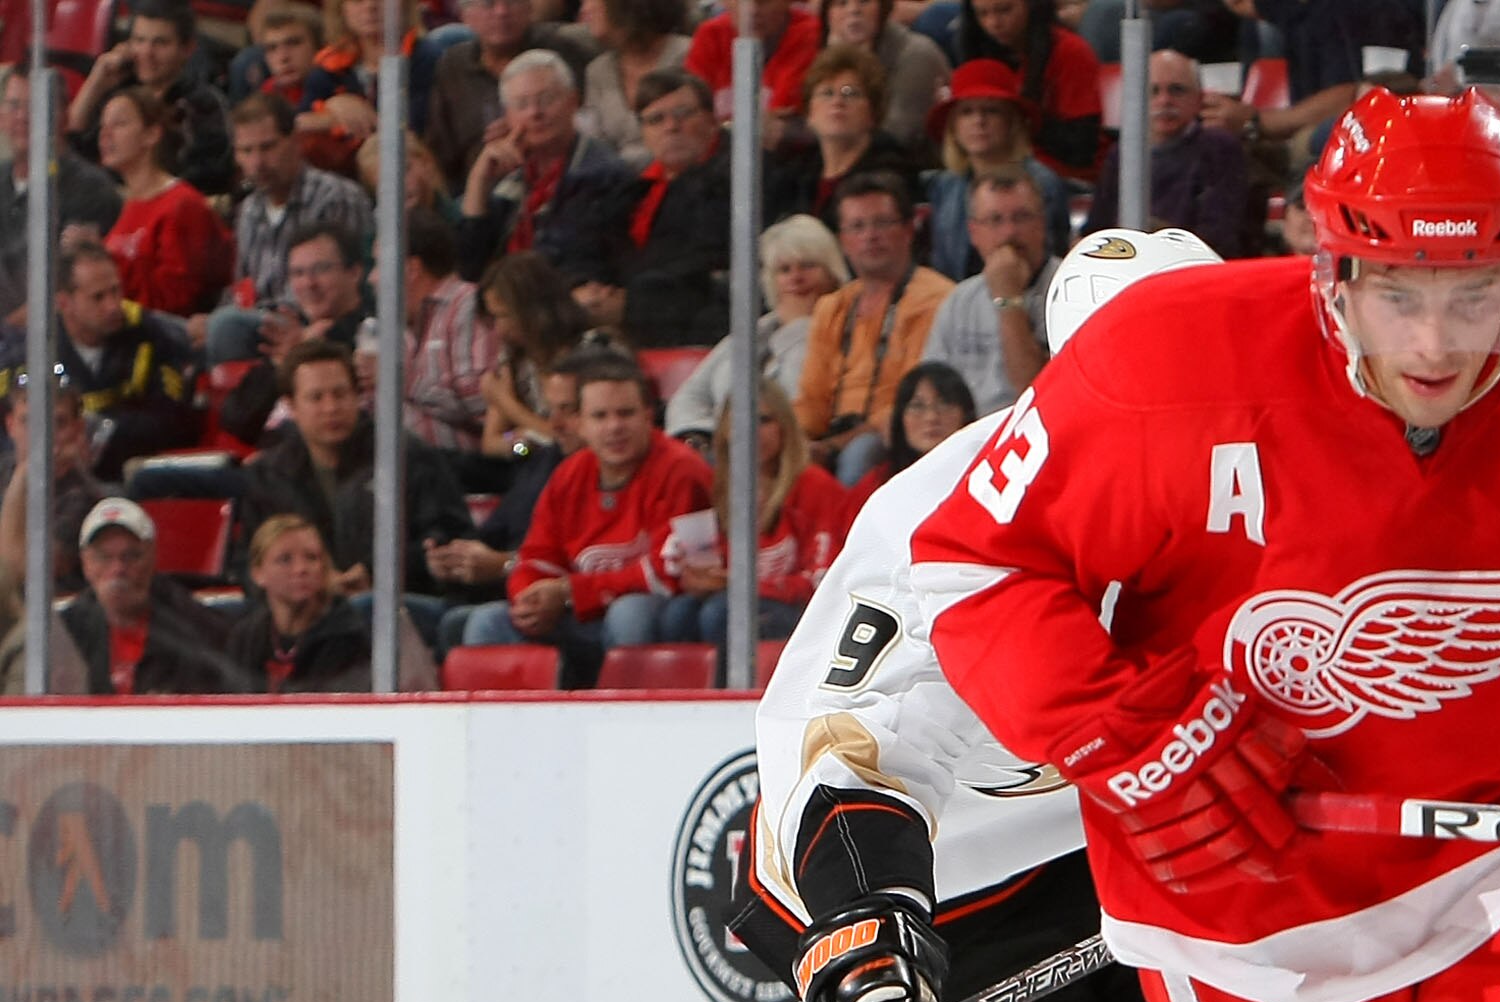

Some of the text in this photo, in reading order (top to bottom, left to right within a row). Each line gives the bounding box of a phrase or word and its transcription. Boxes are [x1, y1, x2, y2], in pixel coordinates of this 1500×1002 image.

[1412, 218, 1478, 237] Reebok
[1206, 441, 1267, 547] A
[819, 592, 903, 693] 9
[1106, 677, 1247, 807] Reebok
